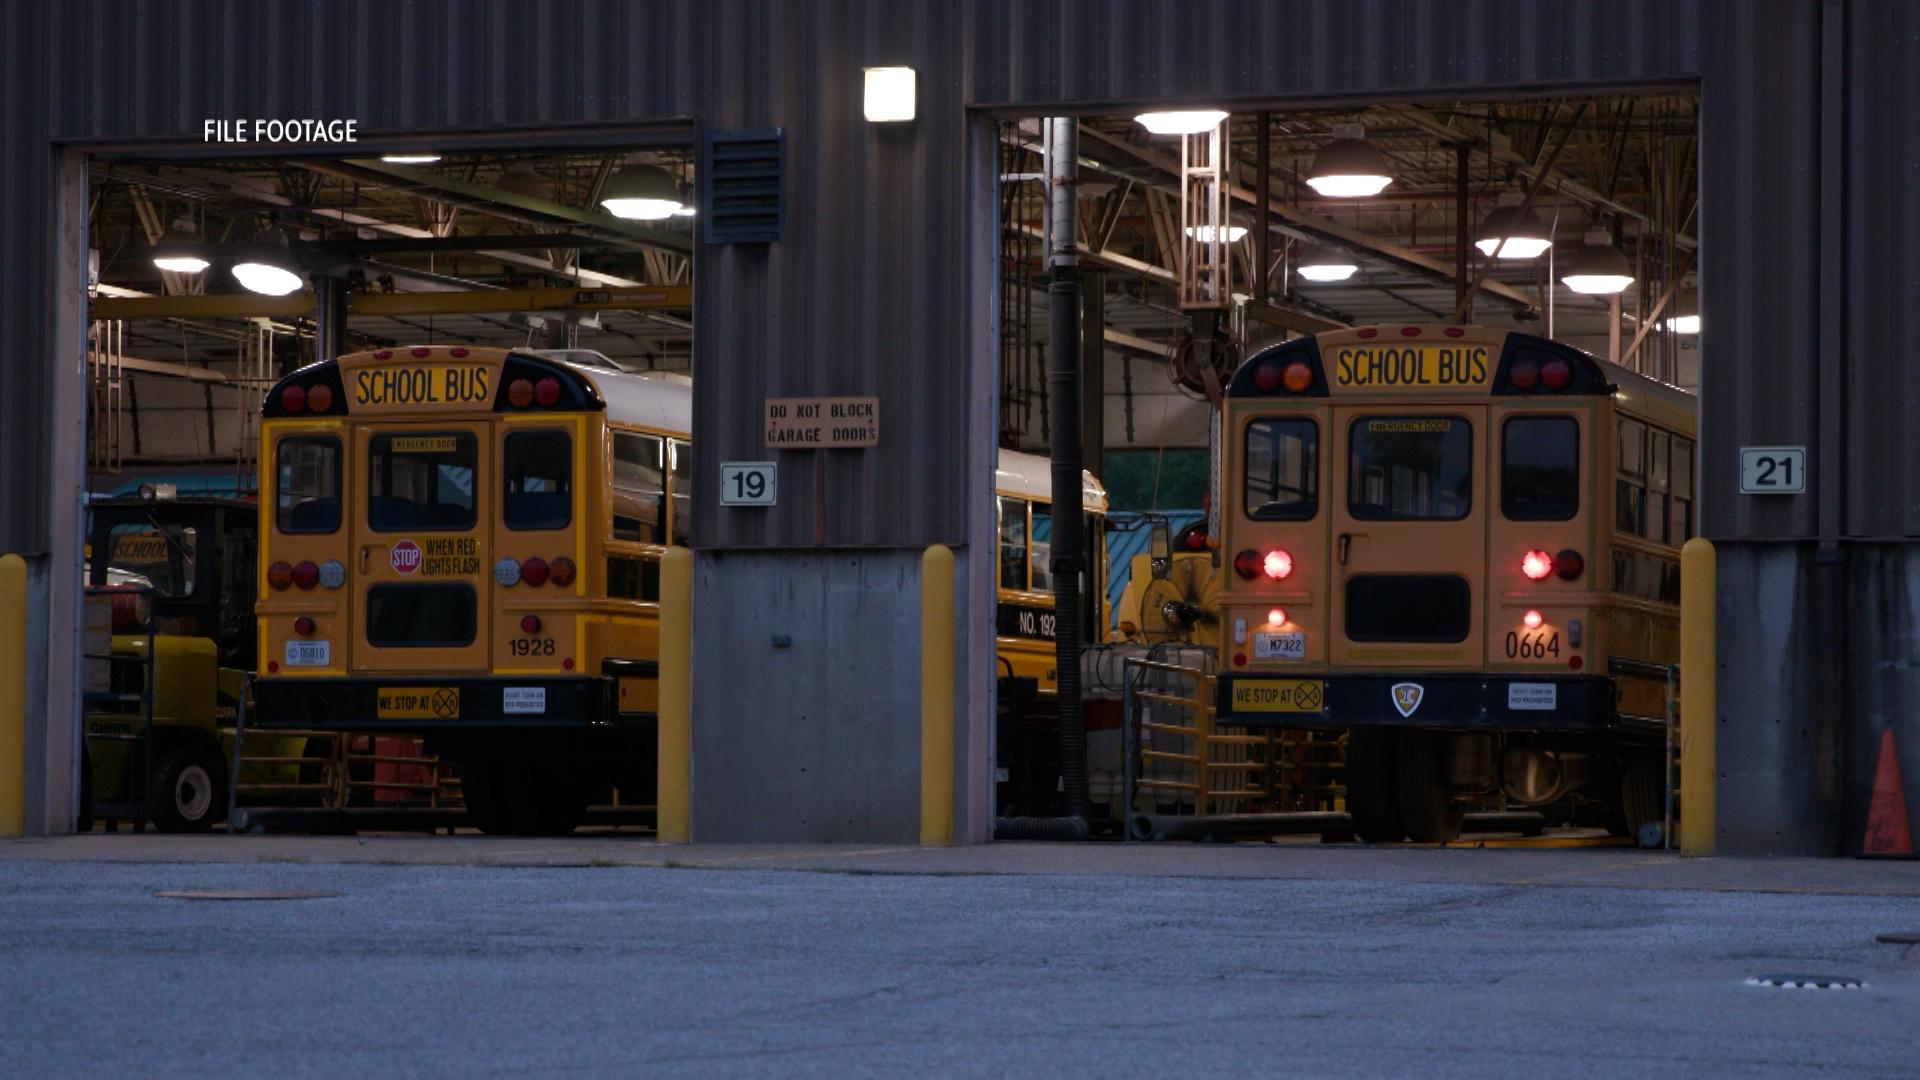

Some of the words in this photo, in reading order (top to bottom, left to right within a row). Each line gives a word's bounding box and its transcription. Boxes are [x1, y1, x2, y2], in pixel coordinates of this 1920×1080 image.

[1337, 349, 1430, 385] SCHOOL
[1438, 348, 1487, 384] BUS
[356, 369, 439, 405] SCHOOL
[445, 367, 488, 402] BUS
[770, 405, 787, 418] DO
[796, 404, 821, 418] NOT
[831, 403, 873, 418] BLOCK
[768, 427, 821, 442] GARAGE
[832, 427, 876, 442] DOORS
[1756, 457, 1793, 486] 21
[732, 471, 765, 498] 19
[114, 541, 168, 558] SCHOOL
[426, 539, 454, 556] WHEN
[457, 538, 475, 556] RED
[393, 549, 419, 566] STOP
[421, 557, 451, 575] LIGHTS
[453, 557, 480, 575] FLASH
[1019, 612, 1037, 635] NO.
[509, 638, 556, 656] 1928
[1506, 631, 1559, 658] 0664
[378, 696, 392, 710] WE
[394, 695, 417, 710] STOP
[419, 695, 430, 710] AT
[1236, 688, 1250, 703] WE
[1254, 688, 1278, 703] STOP
[1280, 688, 1292, 703] AT
